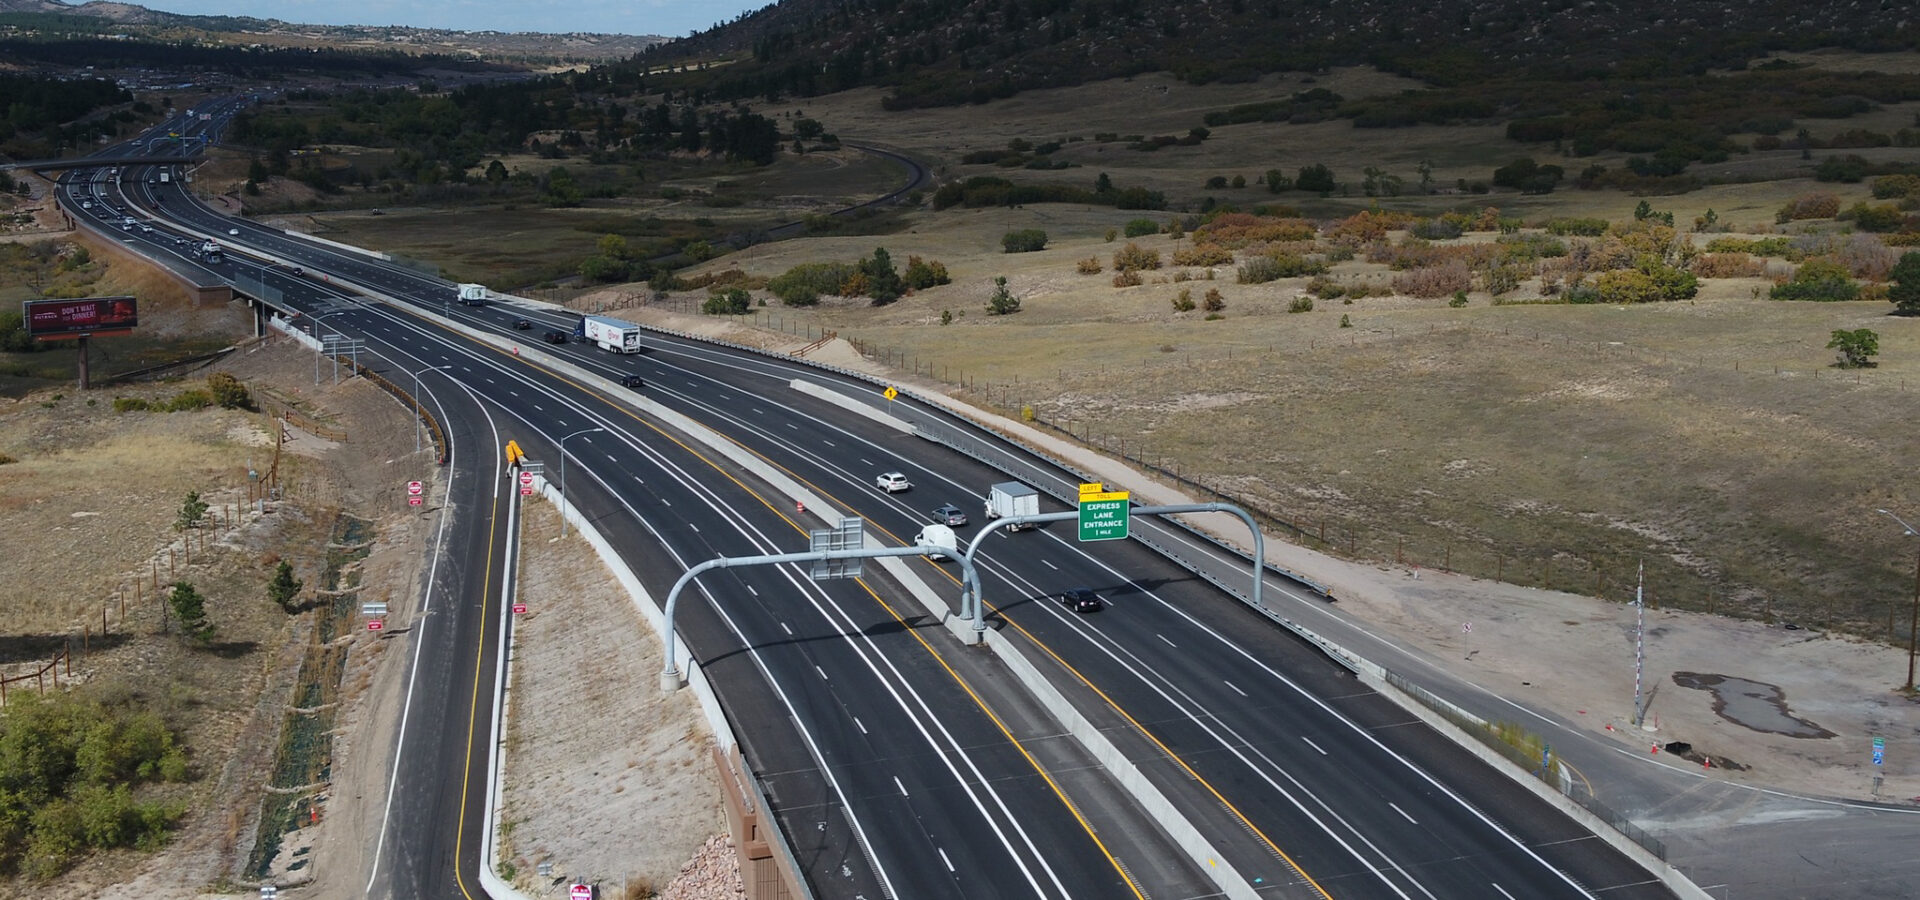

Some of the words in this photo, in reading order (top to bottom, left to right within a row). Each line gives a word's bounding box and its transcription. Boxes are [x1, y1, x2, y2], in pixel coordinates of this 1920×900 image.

[62, 306, 79, 315] DON'T
[81, 304, 96, 312] WAIT
[72, 311, 96, 320] DINNER!
[1087, 503, 1120, 511] EXPRESS
[1084, 520, 1123, 528] ENTRANCE
